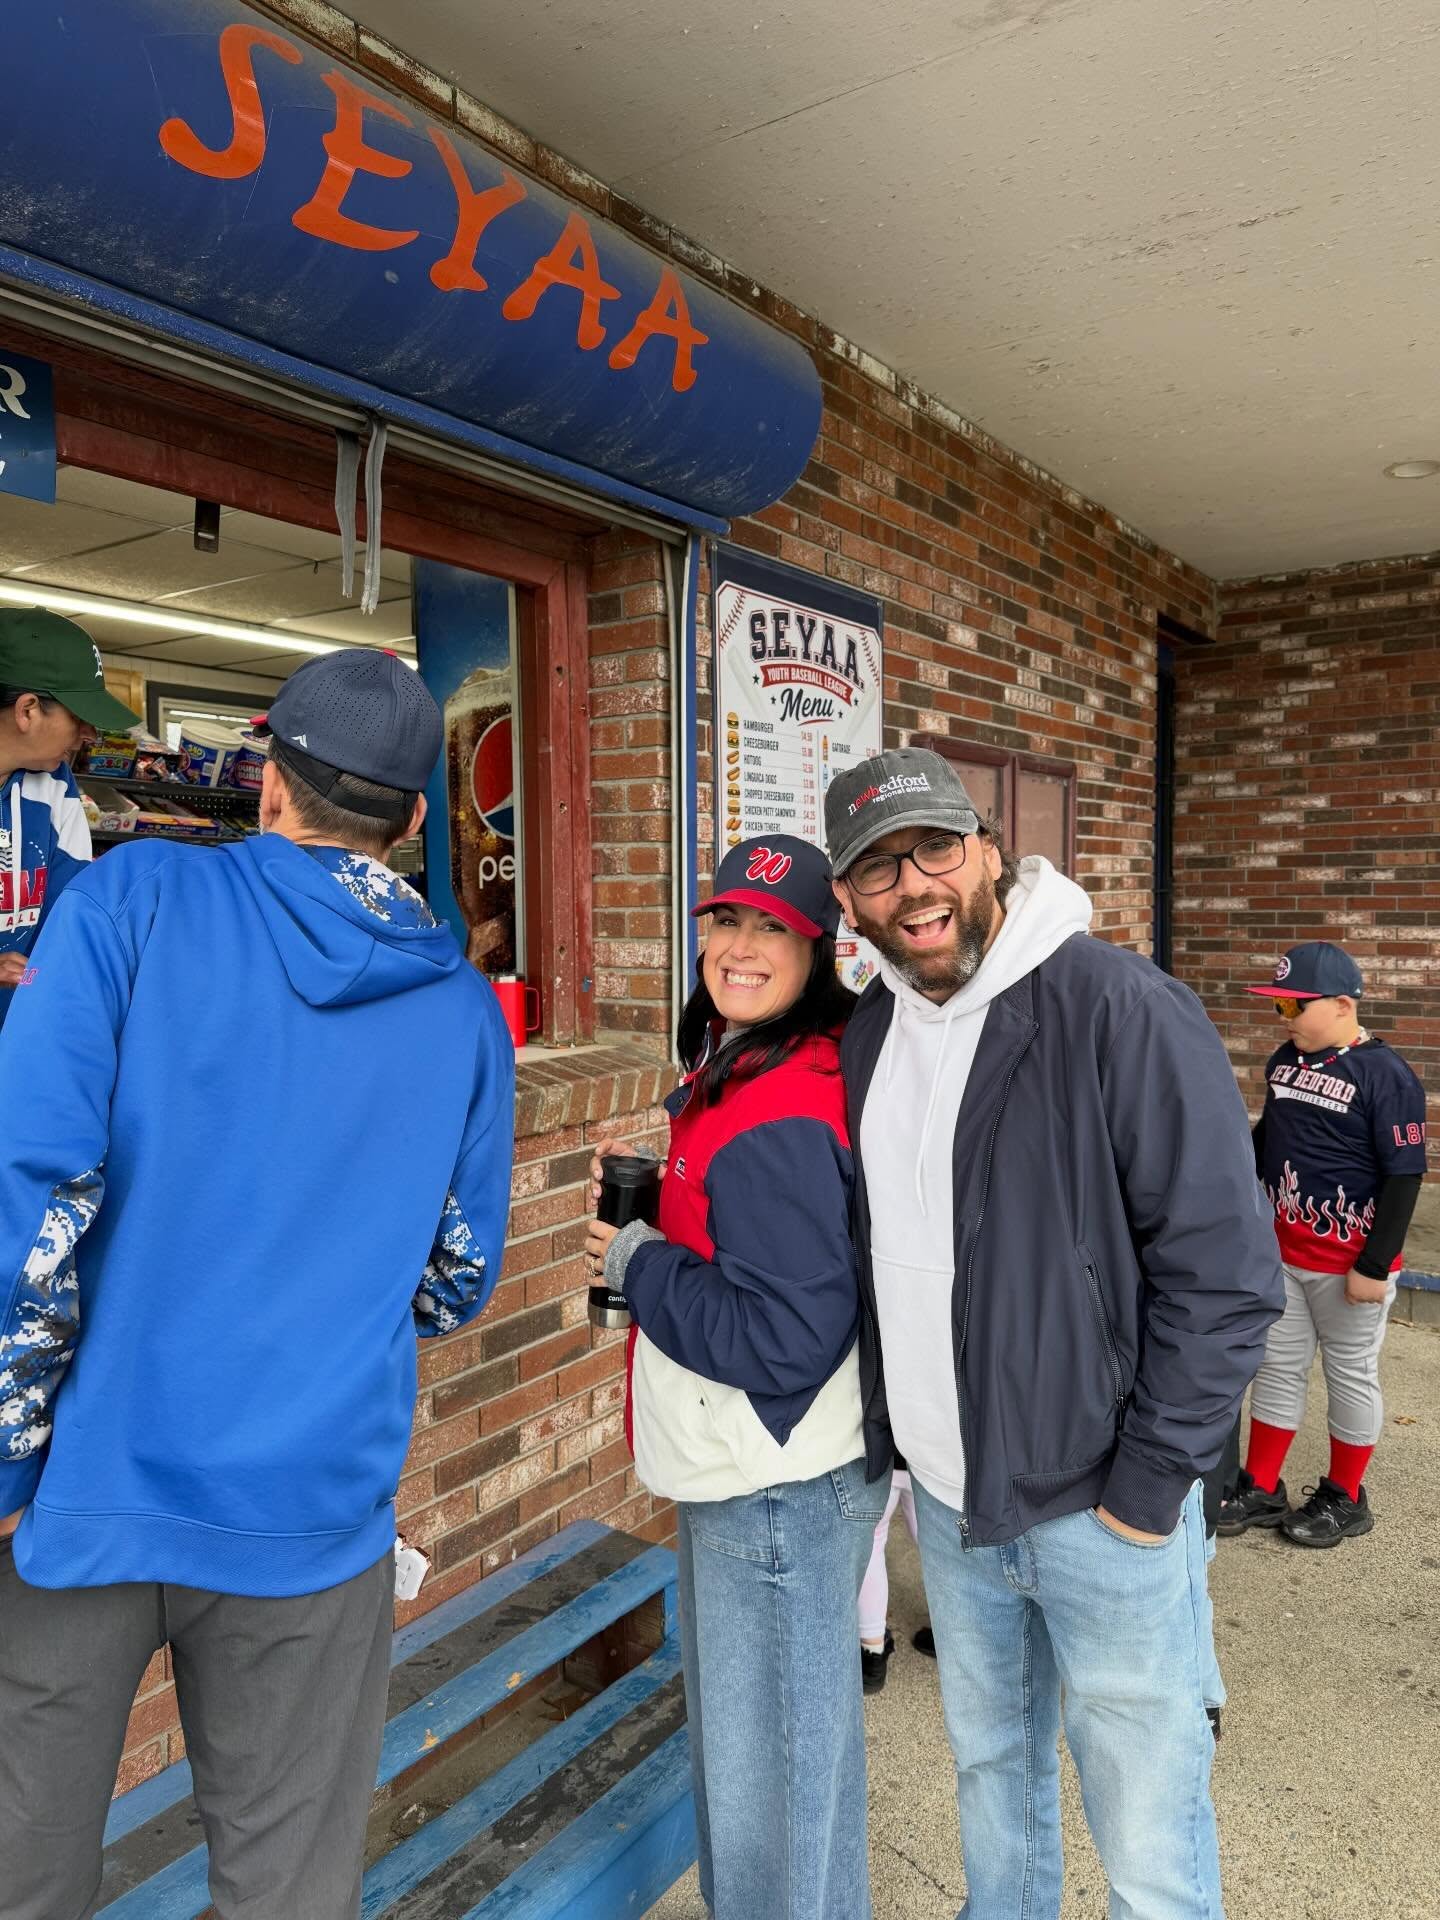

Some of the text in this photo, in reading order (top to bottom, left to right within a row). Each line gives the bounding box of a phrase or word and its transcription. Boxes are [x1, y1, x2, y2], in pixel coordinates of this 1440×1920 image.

[160, 23, 709, 392] SEYAA
[766, 667, 848, 699] YOUTH BASEBALL LEAGUE
[780, 688, 834, 721] Menu
[744, 719, 774, 734] HAMBURGER
[744, 736, 779, 751] CHEESEBURGER
[744, 788, 795, 802] CHOPPED CHEESEBURGER
[872, 784, 932, 804] regional airport
[744, 805, 796, 818] CHICKEN PATTY SANDWICH
[744, 821, 781, 833] CHICKEN TENDERS
[746, 846, 792, 884] W
[1292, 1068, 1357, 1103] BEDFORD
[1288, 1089, 1346, 1113] FIREFIGHTERS
